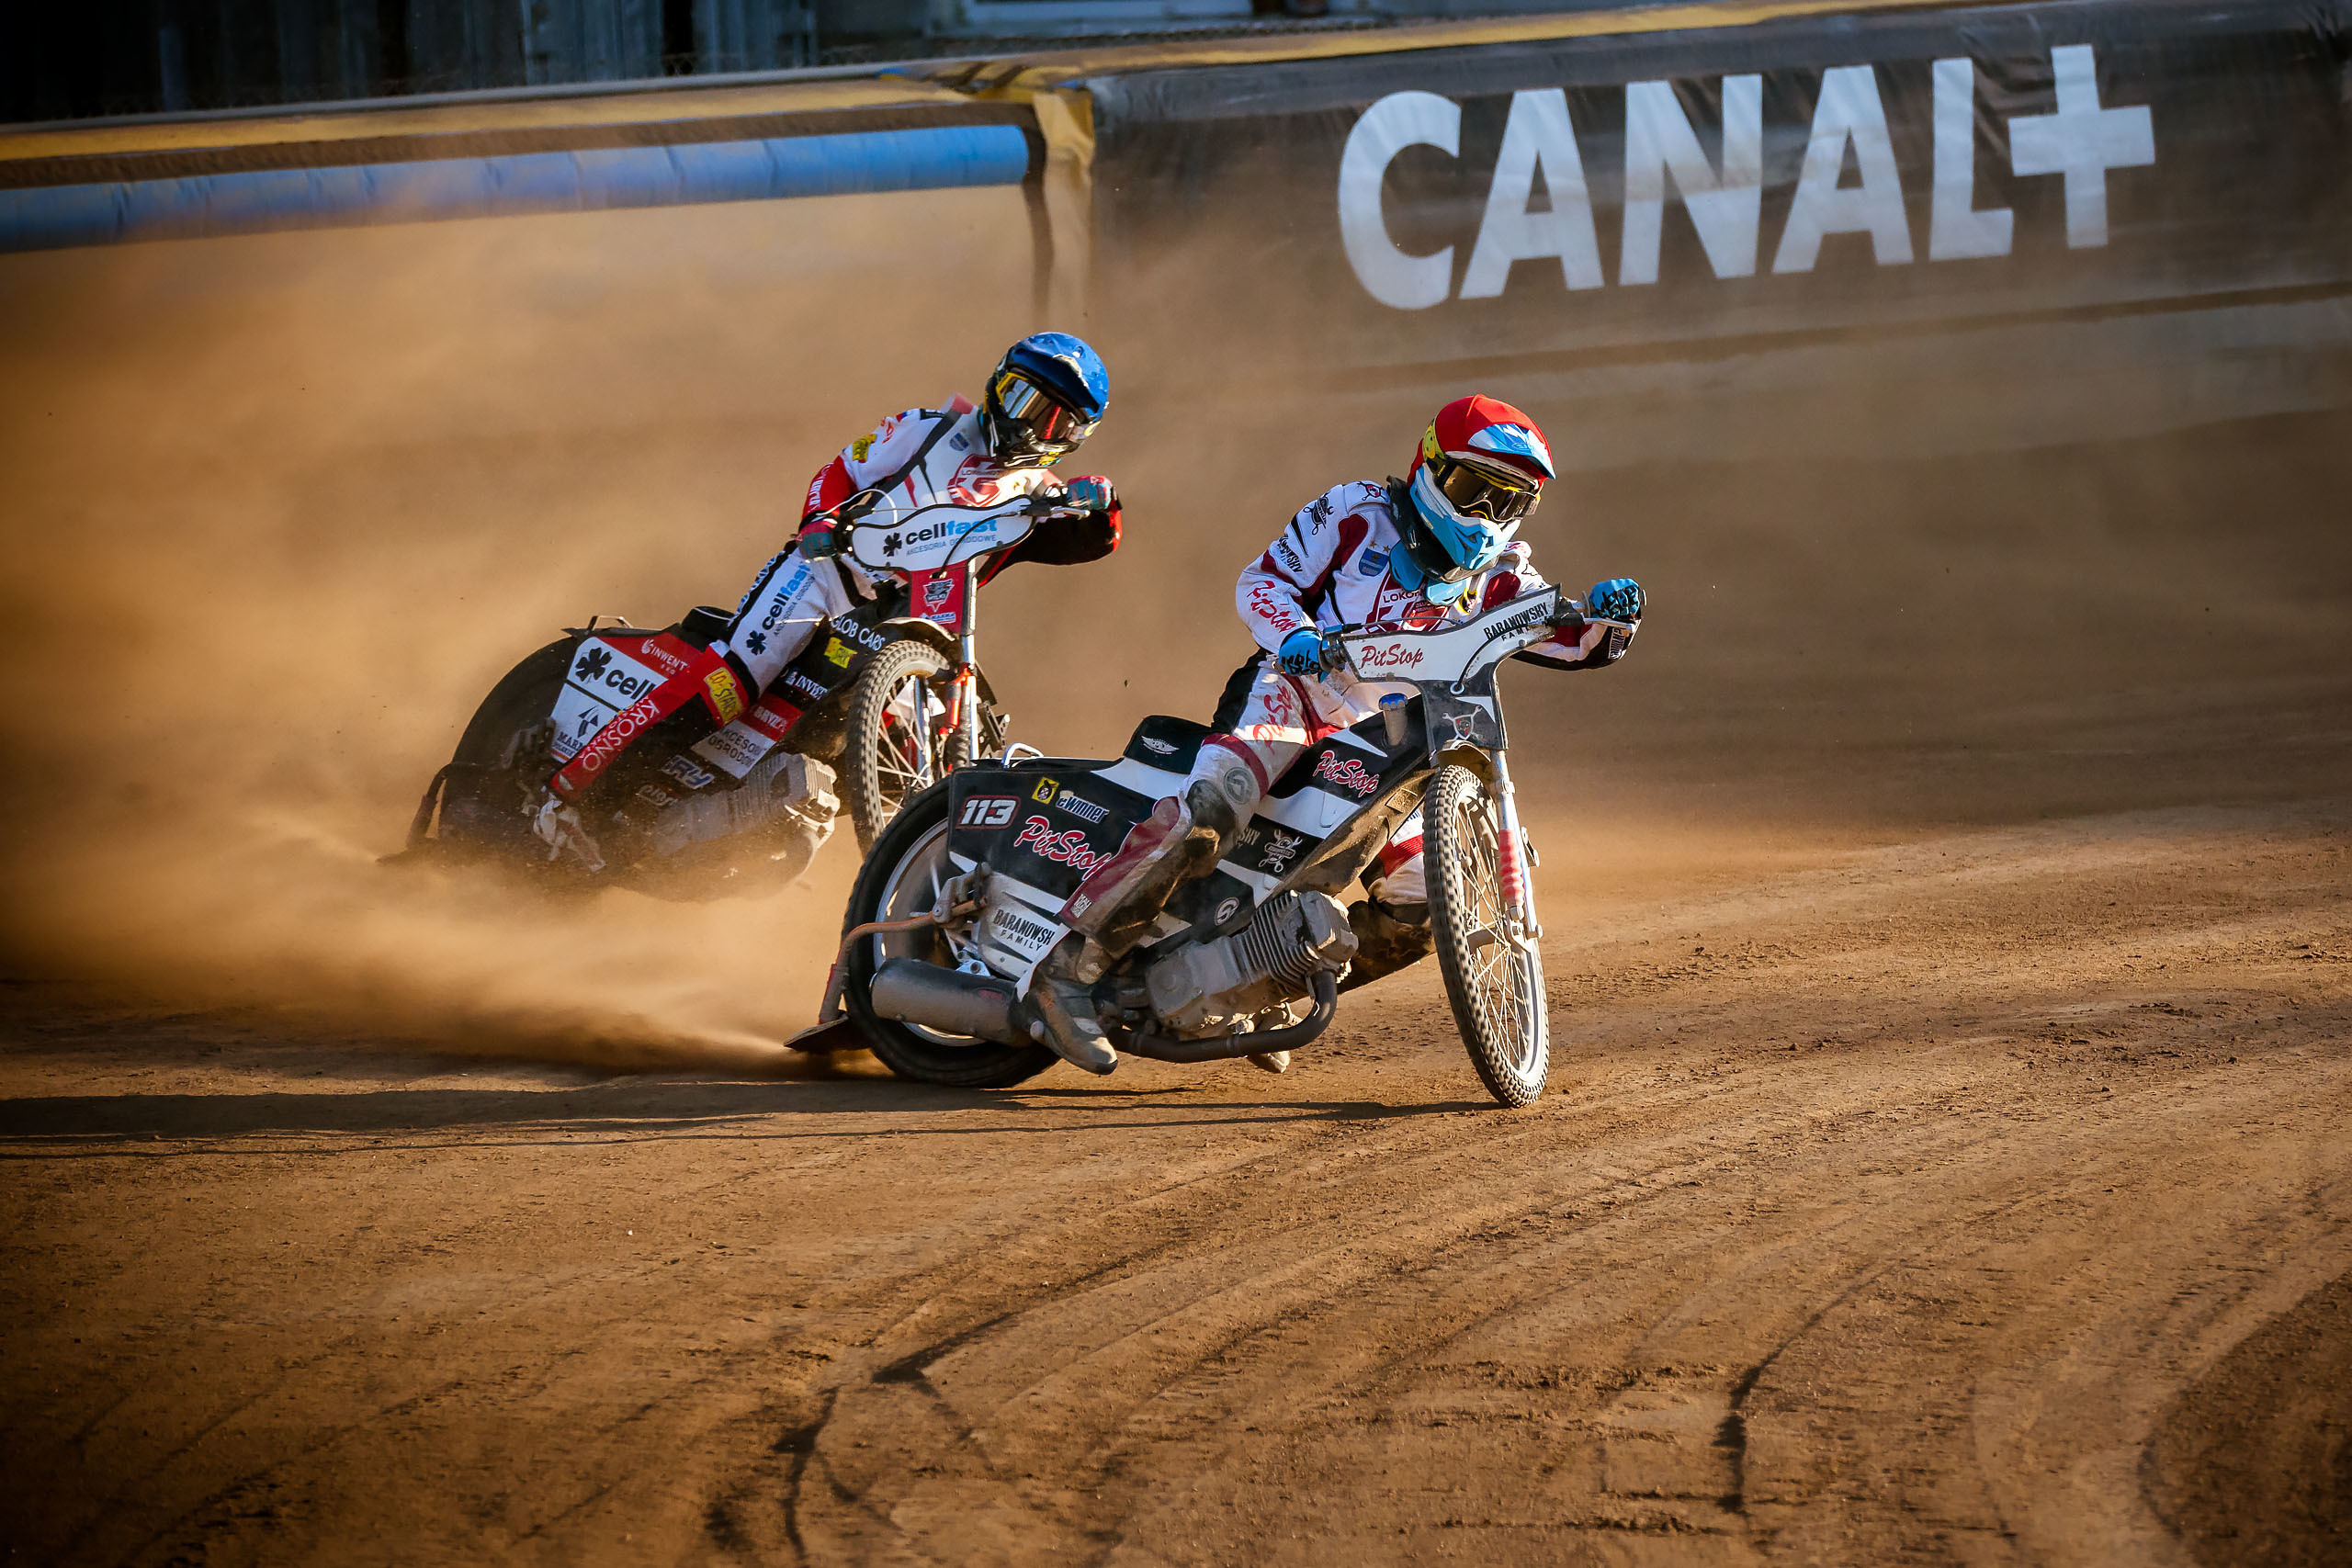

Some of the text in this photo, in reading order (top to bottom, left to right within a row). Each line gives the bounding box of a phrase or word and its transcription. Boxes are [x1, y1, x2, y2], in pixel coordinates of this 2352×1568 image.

[1338, 44, 2156, 310] CANAL+
[906, 520, 998, 545] cellfast
[762, 563, 811, 631] cellfast
[831, 615, 887, 651] GLOB CARS
[1483, 602, 1550, 640] BARANOWSKY
[650, 646, 688, 671] INWENT
[1361, 644, 1424, 670] PitStop
[582, 699, 660, 772] KROSNO
[1313, 750, 1380, 799] PitStop
[960, 799, 1017, 826] 113
[1000, 929, 1043, 952] FAMILY
